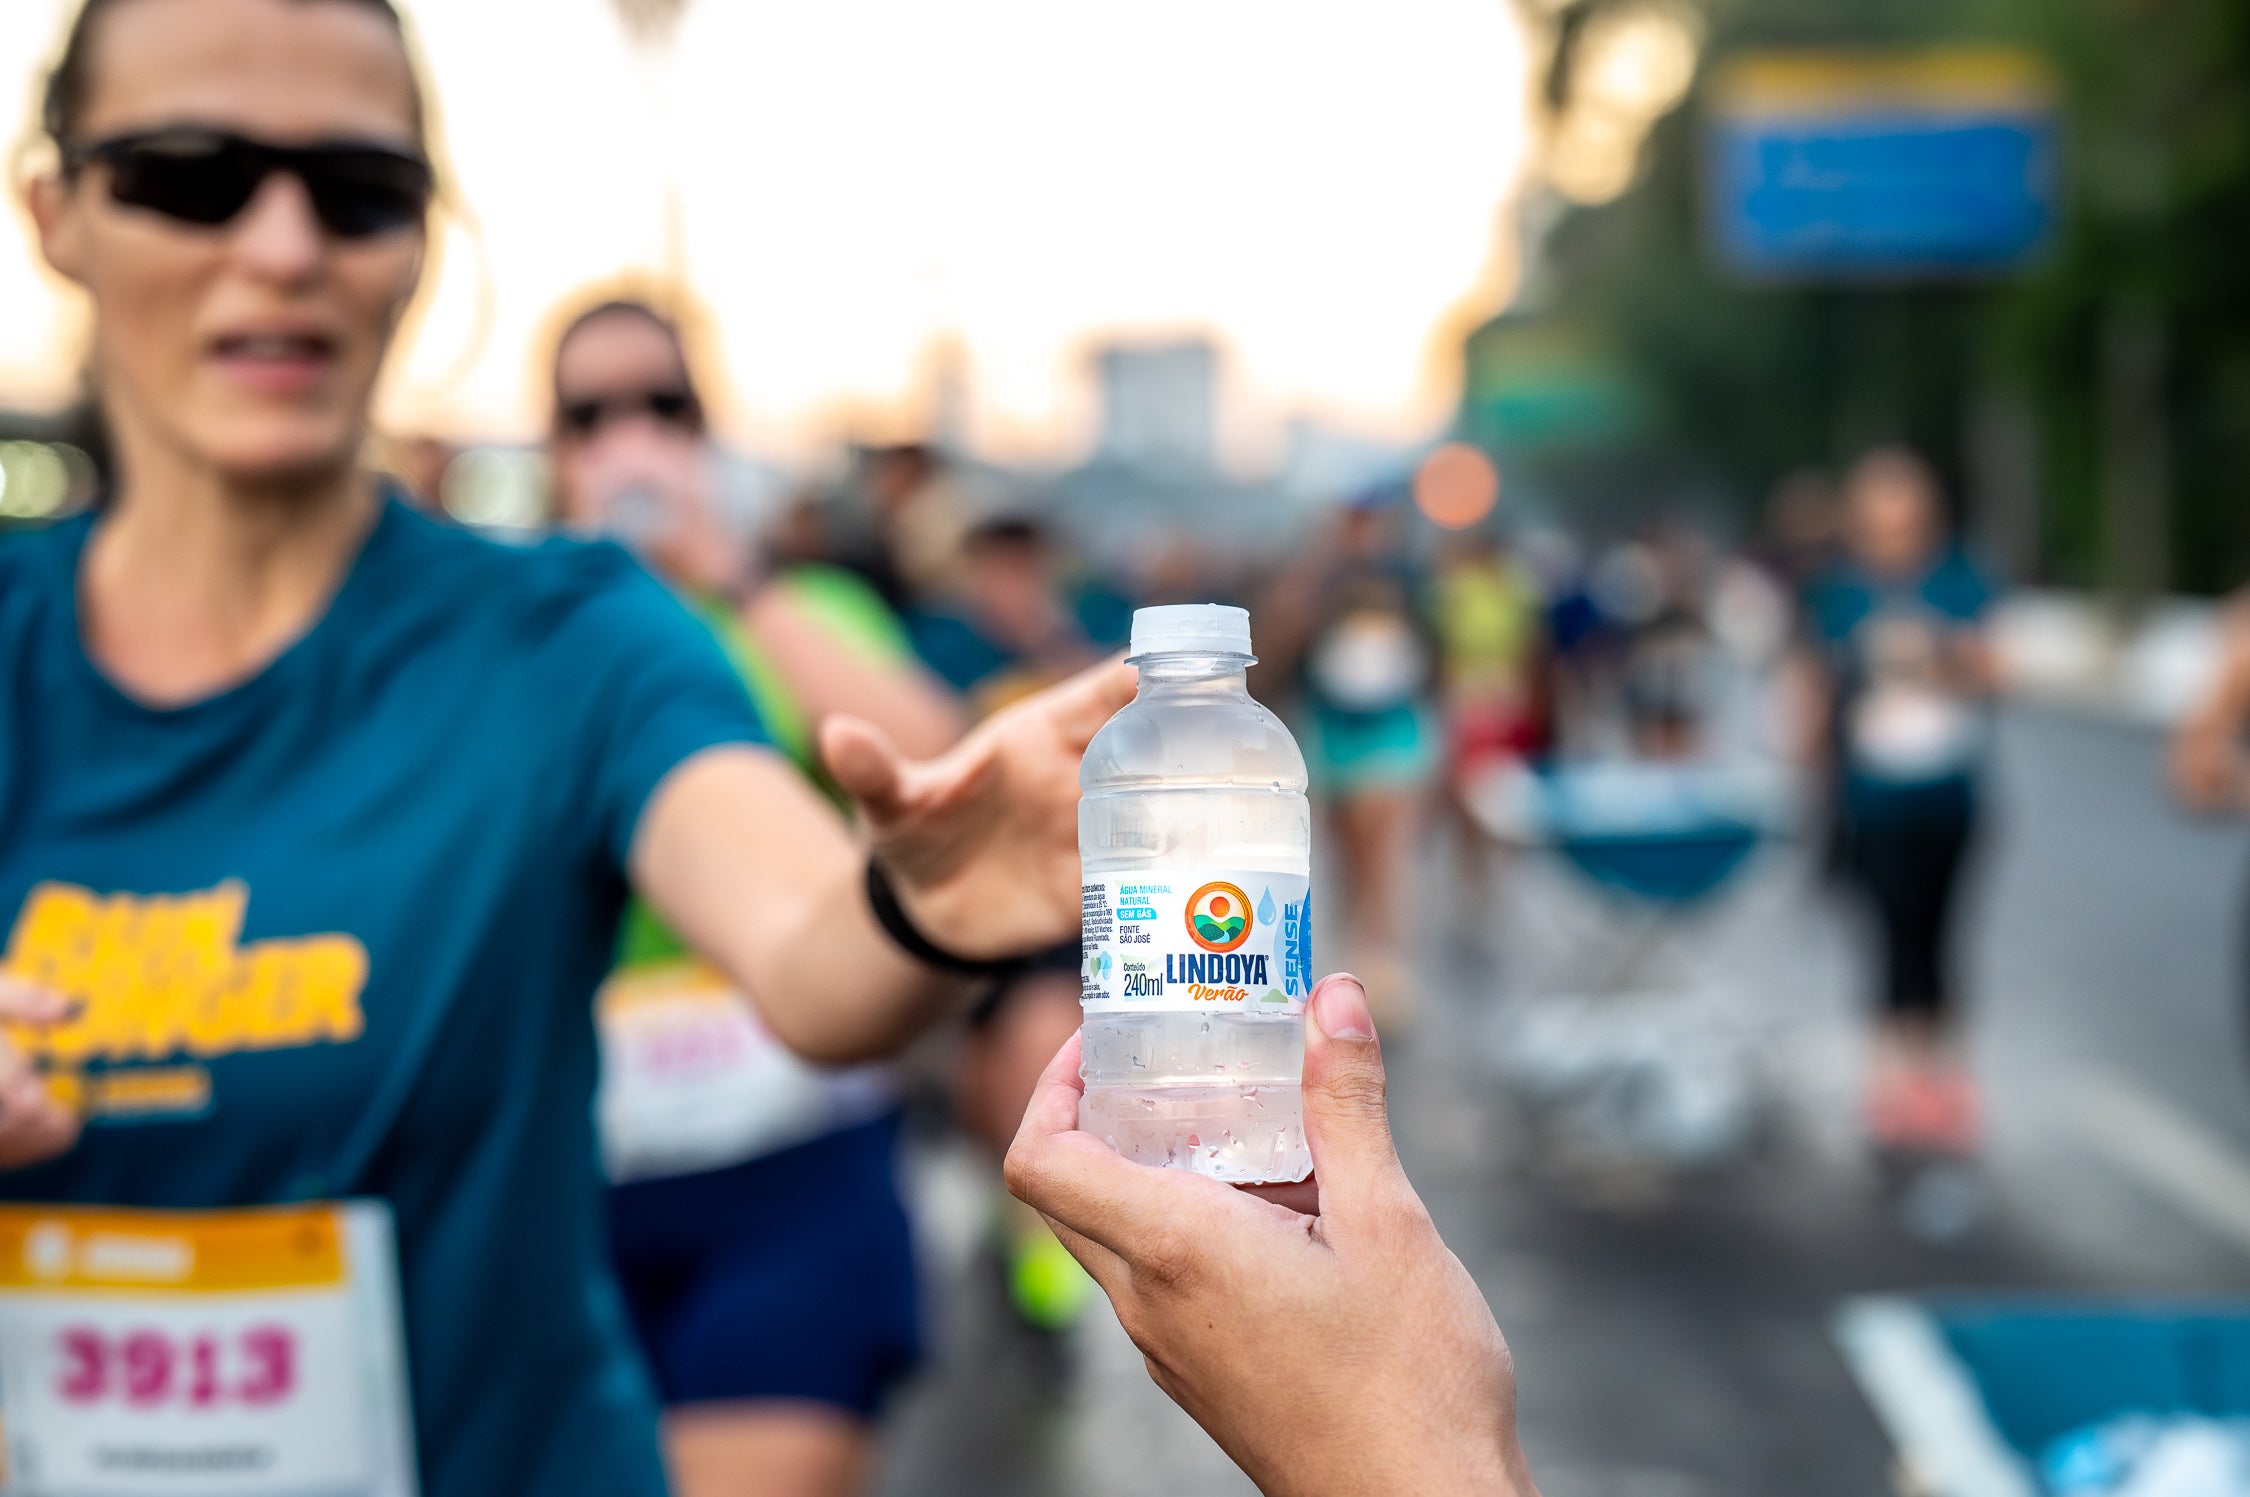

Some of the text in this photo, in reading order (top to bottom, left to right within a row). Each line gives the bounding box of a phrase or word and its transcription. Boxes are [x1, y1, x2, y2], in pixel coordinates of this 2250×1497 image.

[1119, 884, 1173, 895] ÁGUA MINERAL
[1119, 896, 1150, 905] NATURAL
[1120, 909, 1134, 919] SEM
[1119, 925, 1140, 934] FONTE
[1119, 933, 1133, 944] SÃO
[1134, 932, 1151, 944] JOSÉ
[1284, 903, 1299, 997] SENSE
[1166, 953, 1268, 986] LINDOYA
[1123, 972, 1163, 997] 240ml
[1187, 983, 1249, 1002] Verão
